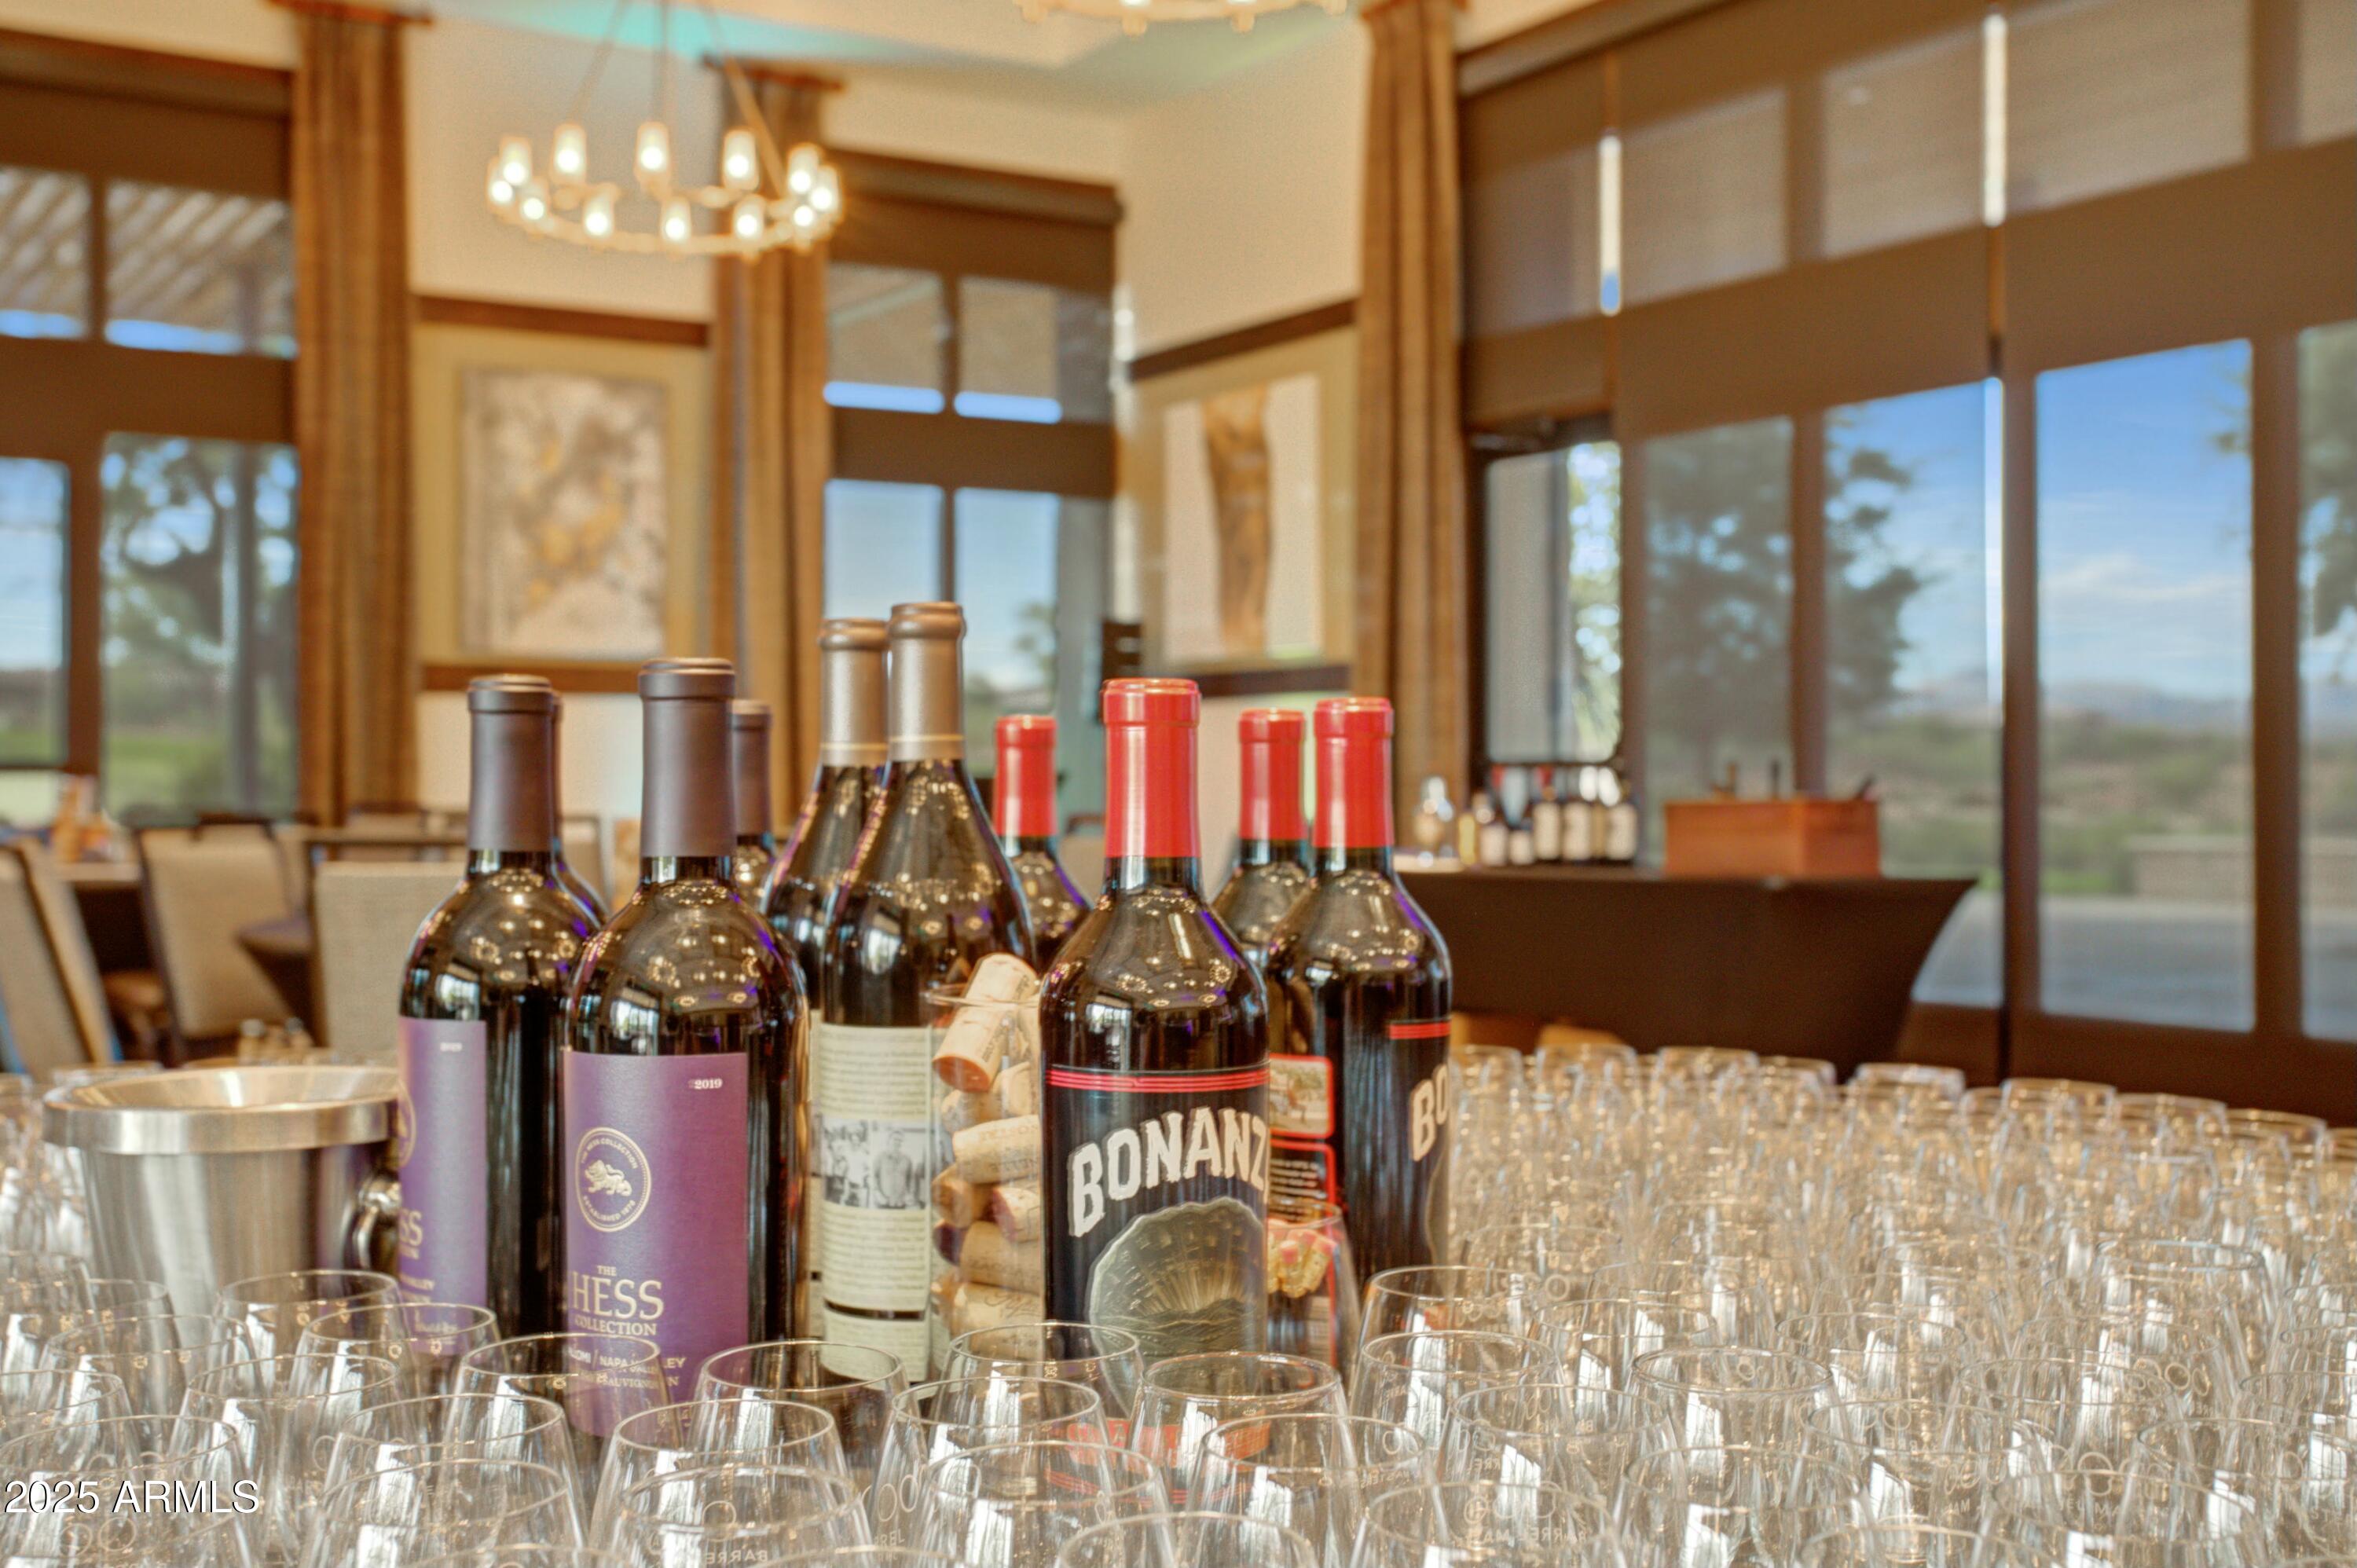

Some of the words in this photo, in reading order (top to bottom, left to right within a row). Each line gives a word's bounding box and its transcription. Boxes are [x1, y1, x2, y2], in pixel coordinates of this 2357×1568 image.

[694, 1078, 723, 1090] 2019
[1067, 1105, 1270, 1238] BONANZ
[597, 1265, 617, 1277] THE
[572, 1271, 665, 1321] HESS
[575, 1314, 657, 1336] COLLECTION
